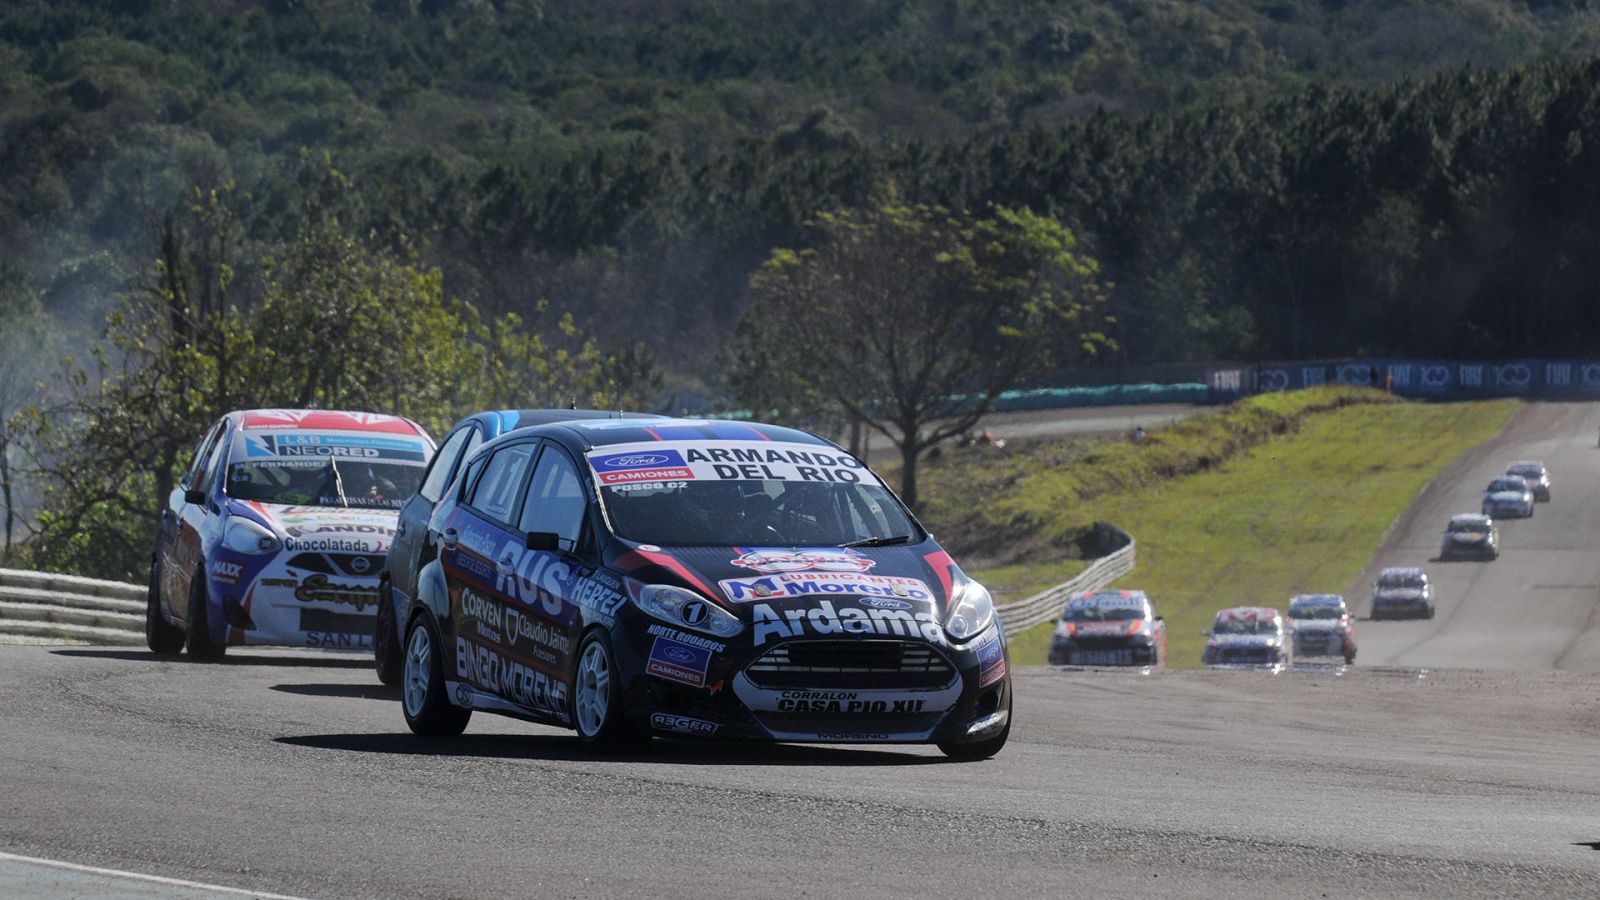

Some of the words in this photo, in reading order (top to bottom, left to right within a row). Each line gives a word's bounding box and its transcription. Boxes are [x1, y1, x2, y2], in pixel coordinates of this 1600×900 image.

[285, 435, 321, 445] L&B
[286, 446, 380, 458] NEORED
[686, 448, 862, 469] ARMANDO
[617, 455, 657, 466] Ford
[606, 470, 688, 481] CAMIONES
[712, 464, 786, 480] DEL
[795, 466, 861, 484] RIO
[610, 483, 662, 493] POSCO
[666, 481, 688, 489] C2
[285, 537, 370, 553] Chocolatada
[496, 540, 570, 616] RUS
[780, 572, 918, 587] LUBRICANTES
[461, 587, 501, 630] CORVEN
[869, 599, 902, 609] Ford
[689, 602, 704, 623] 1
[519, 614, 548, 644] Claudio
[647, 624, 676, 639] NORTE
[753, 600, 948, 648] Ardama
[306, 632, 350, 646] SAN
[476, 621, 501, 643] Motos
[456, 635, 500, 693] BINGO
[650, 663, 701, 682] CAMIONES
[781, 690, 858, 700] CORRALON
[777, 699, 842, 713] CASA
[847, 699, 888, 713] PIO
